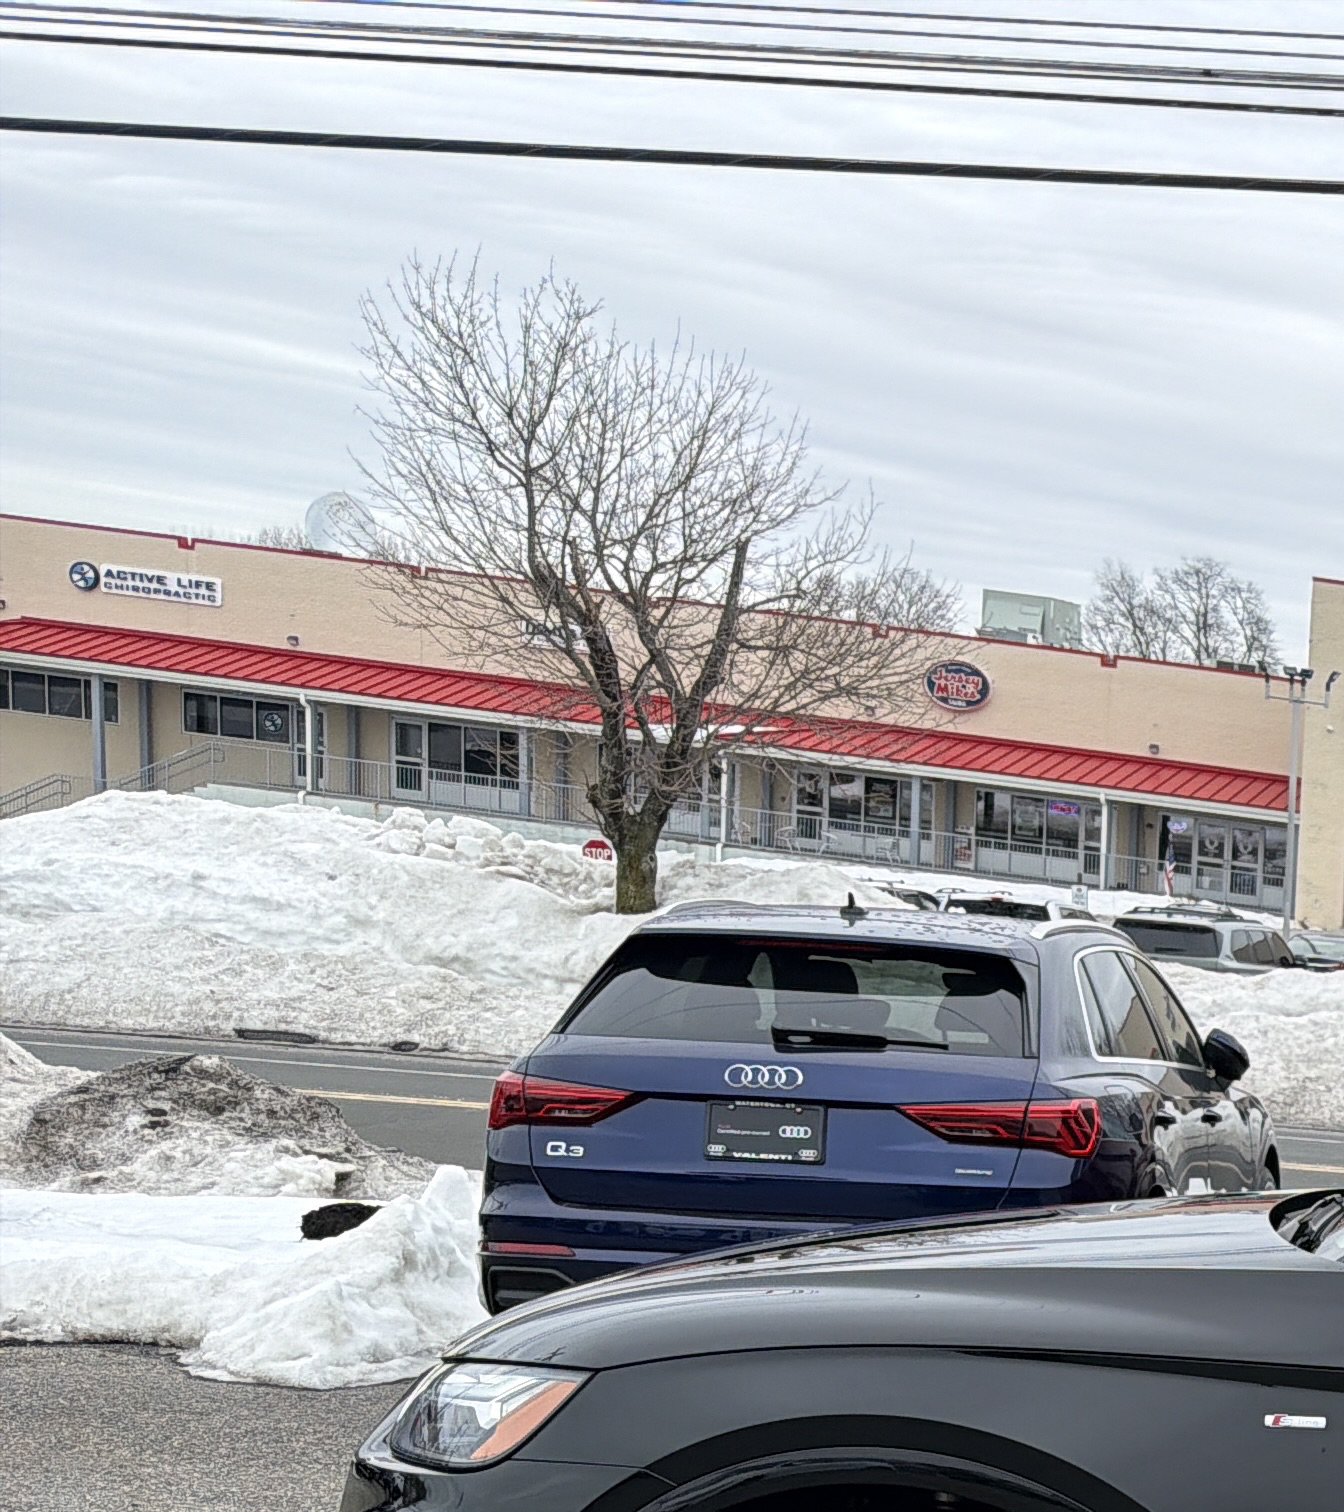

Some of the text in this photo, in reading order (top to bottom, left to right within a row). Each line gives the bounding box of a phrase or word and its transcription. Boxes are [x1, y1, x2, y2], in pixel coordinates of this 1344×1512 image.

[103, 568, 217, 593] ACTIVE LIFE
[103, 581, 217, 603] CHIROPRACTIC
[931, 668, 982, 689] Jersey
[584, 847, 611, 860] STOP
[546, 1141, 584, 1156] Q3
[732, 1151, 792, 1160] VALENTI
